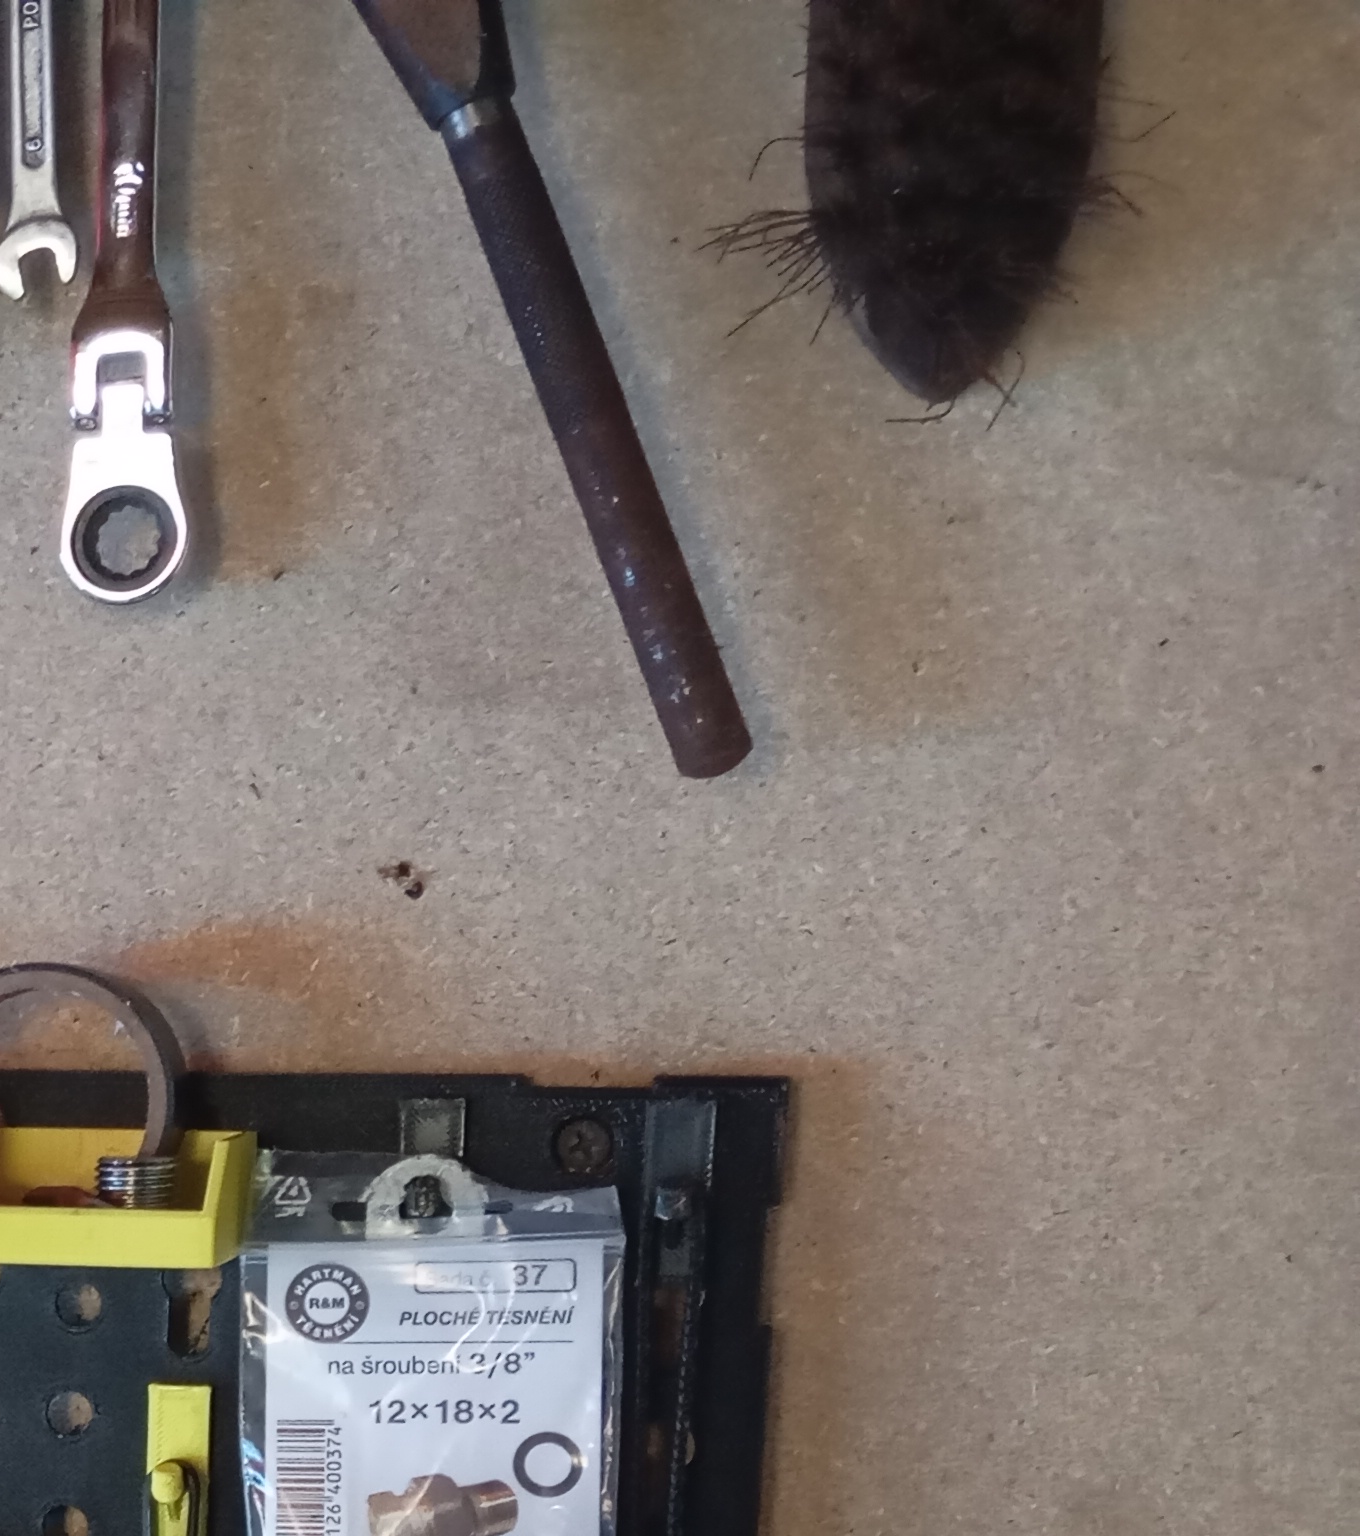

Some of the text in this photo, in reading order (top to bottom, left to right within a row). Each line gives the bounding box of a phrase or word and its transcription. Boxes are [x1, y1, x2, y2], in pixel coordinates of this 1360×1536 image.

[293, 1268, 362, 1296] HARTMAN
[513, 1264, 548, 1286] 37
[309, 1297, 345, 1309] R&M
[327, 1360, 355, 1375] na
[326, 1427, 342, 1495] 400374
